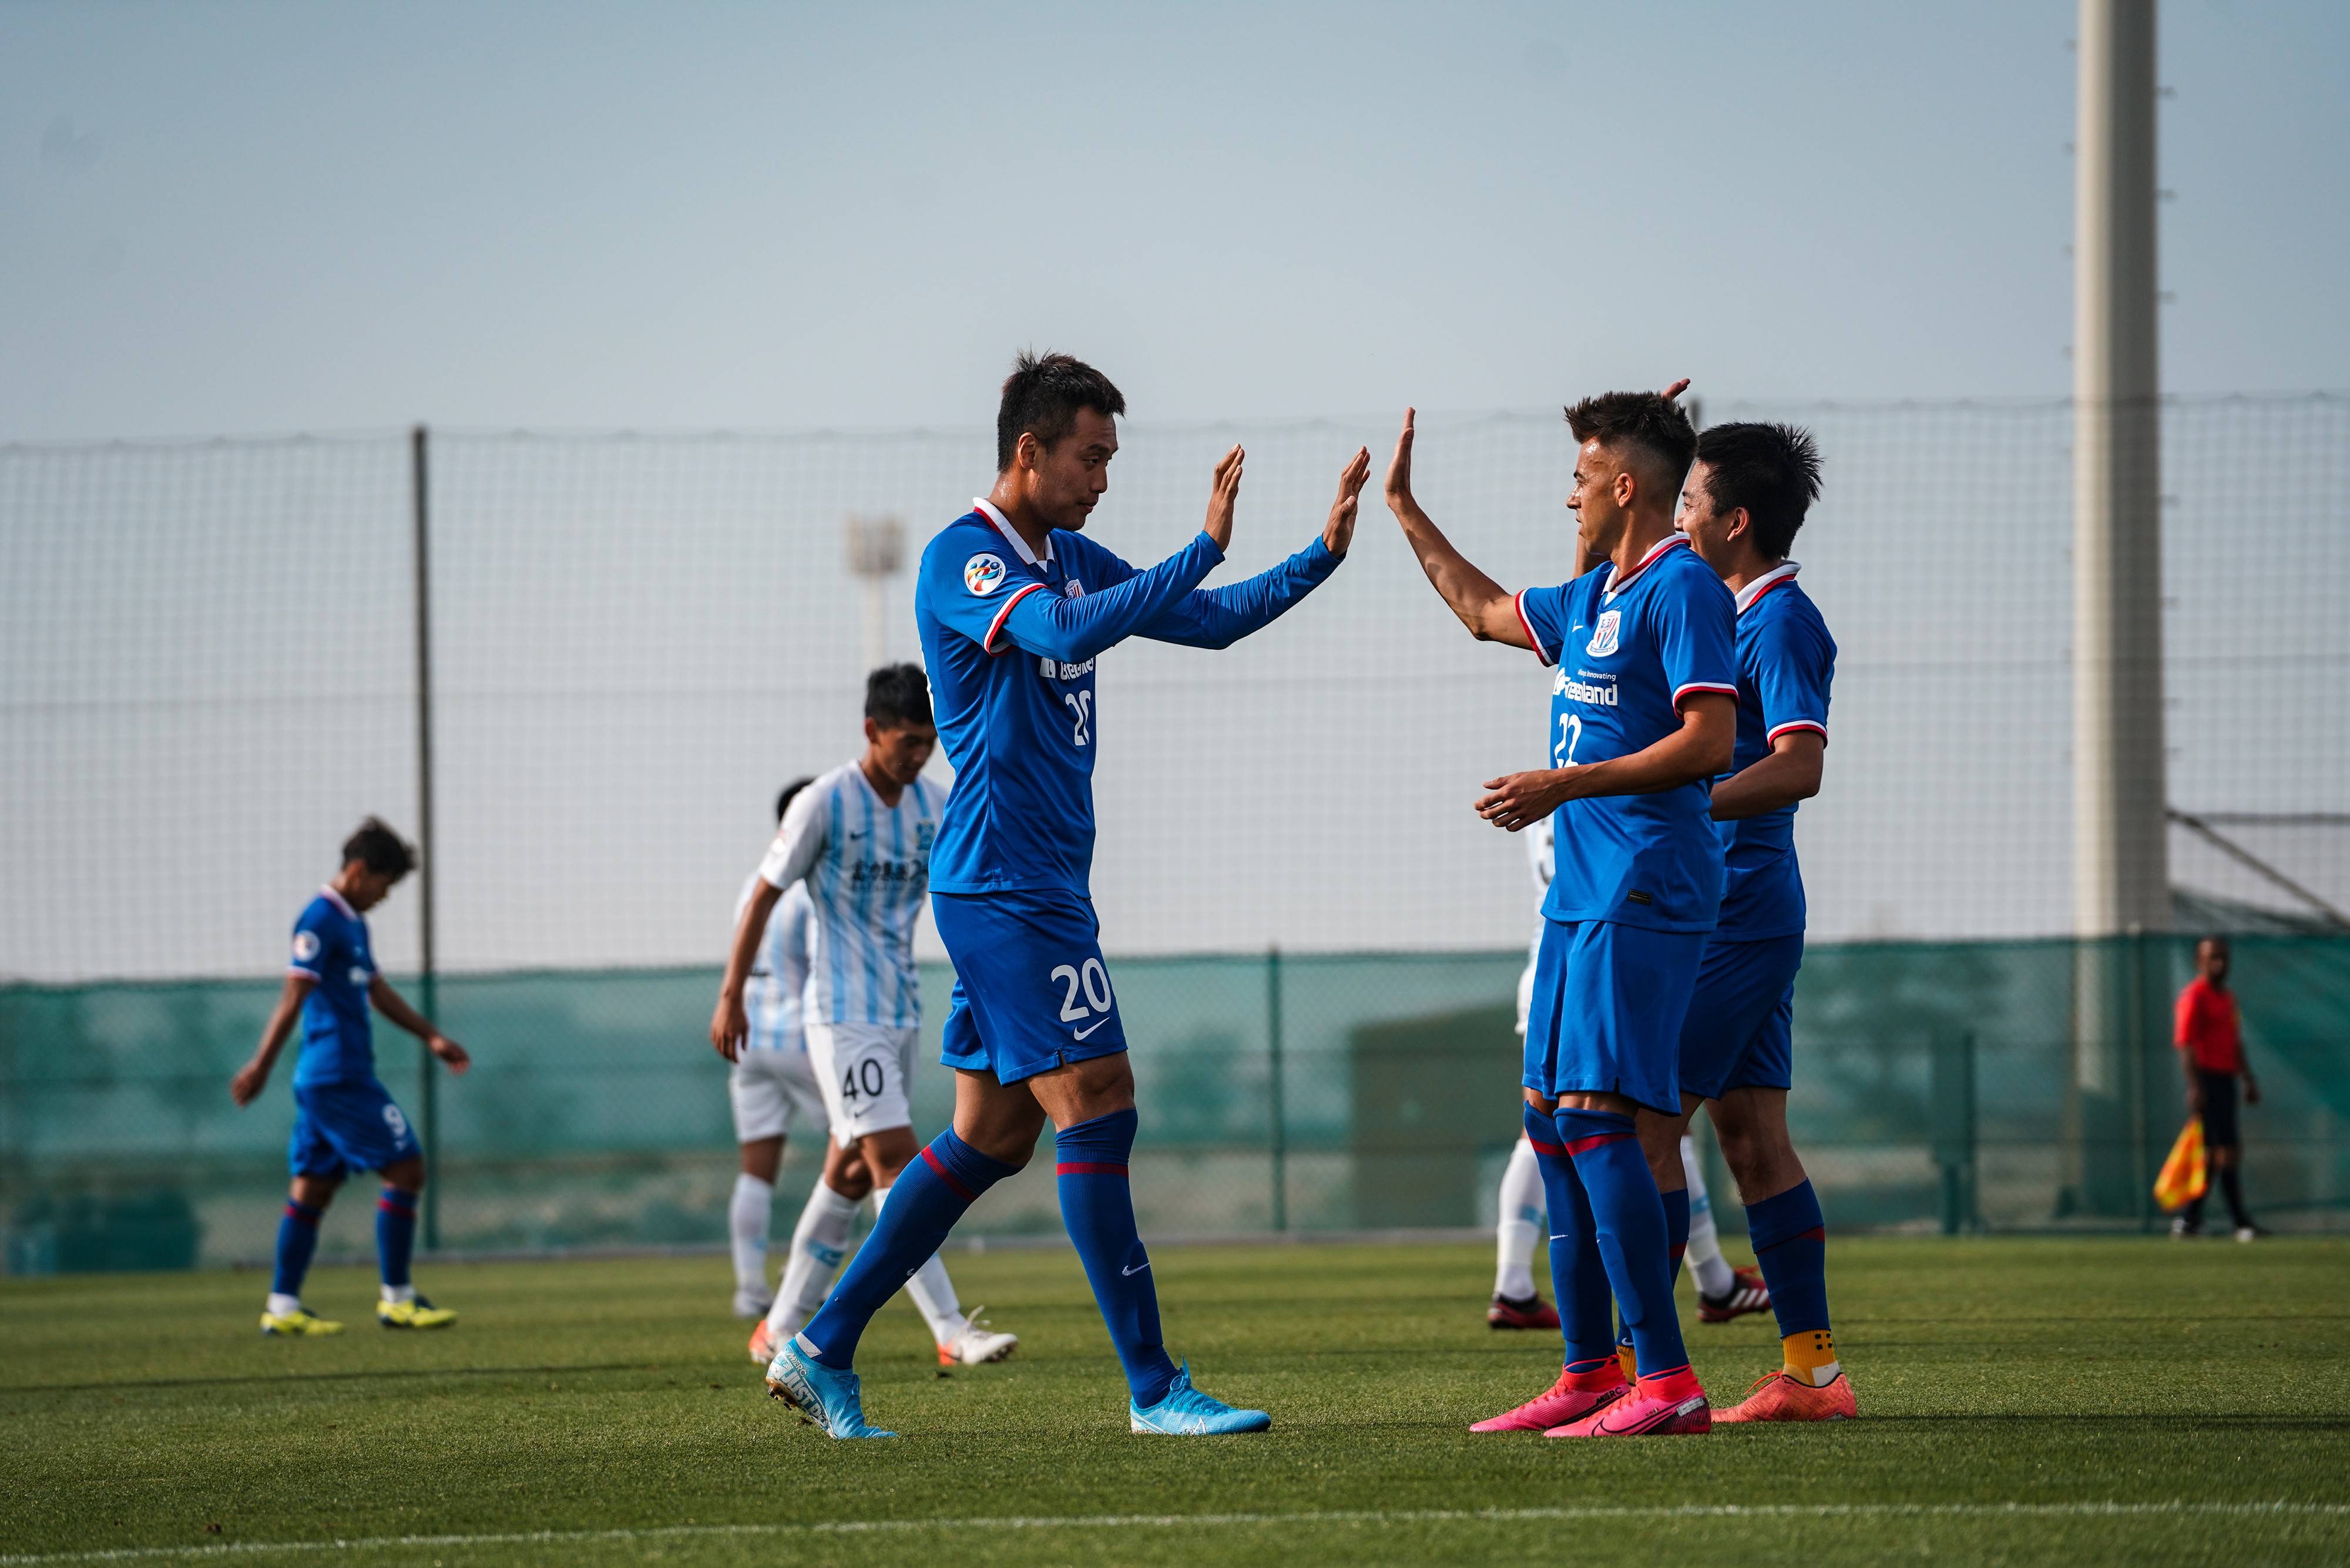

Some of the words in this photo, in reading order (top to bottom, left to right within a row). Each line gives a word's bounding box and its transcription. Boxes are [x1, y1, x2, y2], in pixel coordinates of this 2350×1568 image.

[1554, 713, 1582, 769] 22
[1050, 958, 1112, 1022] 20
[842, 1057, 884, 1100] 40
[781, 1371, 815, 1406] JUST
